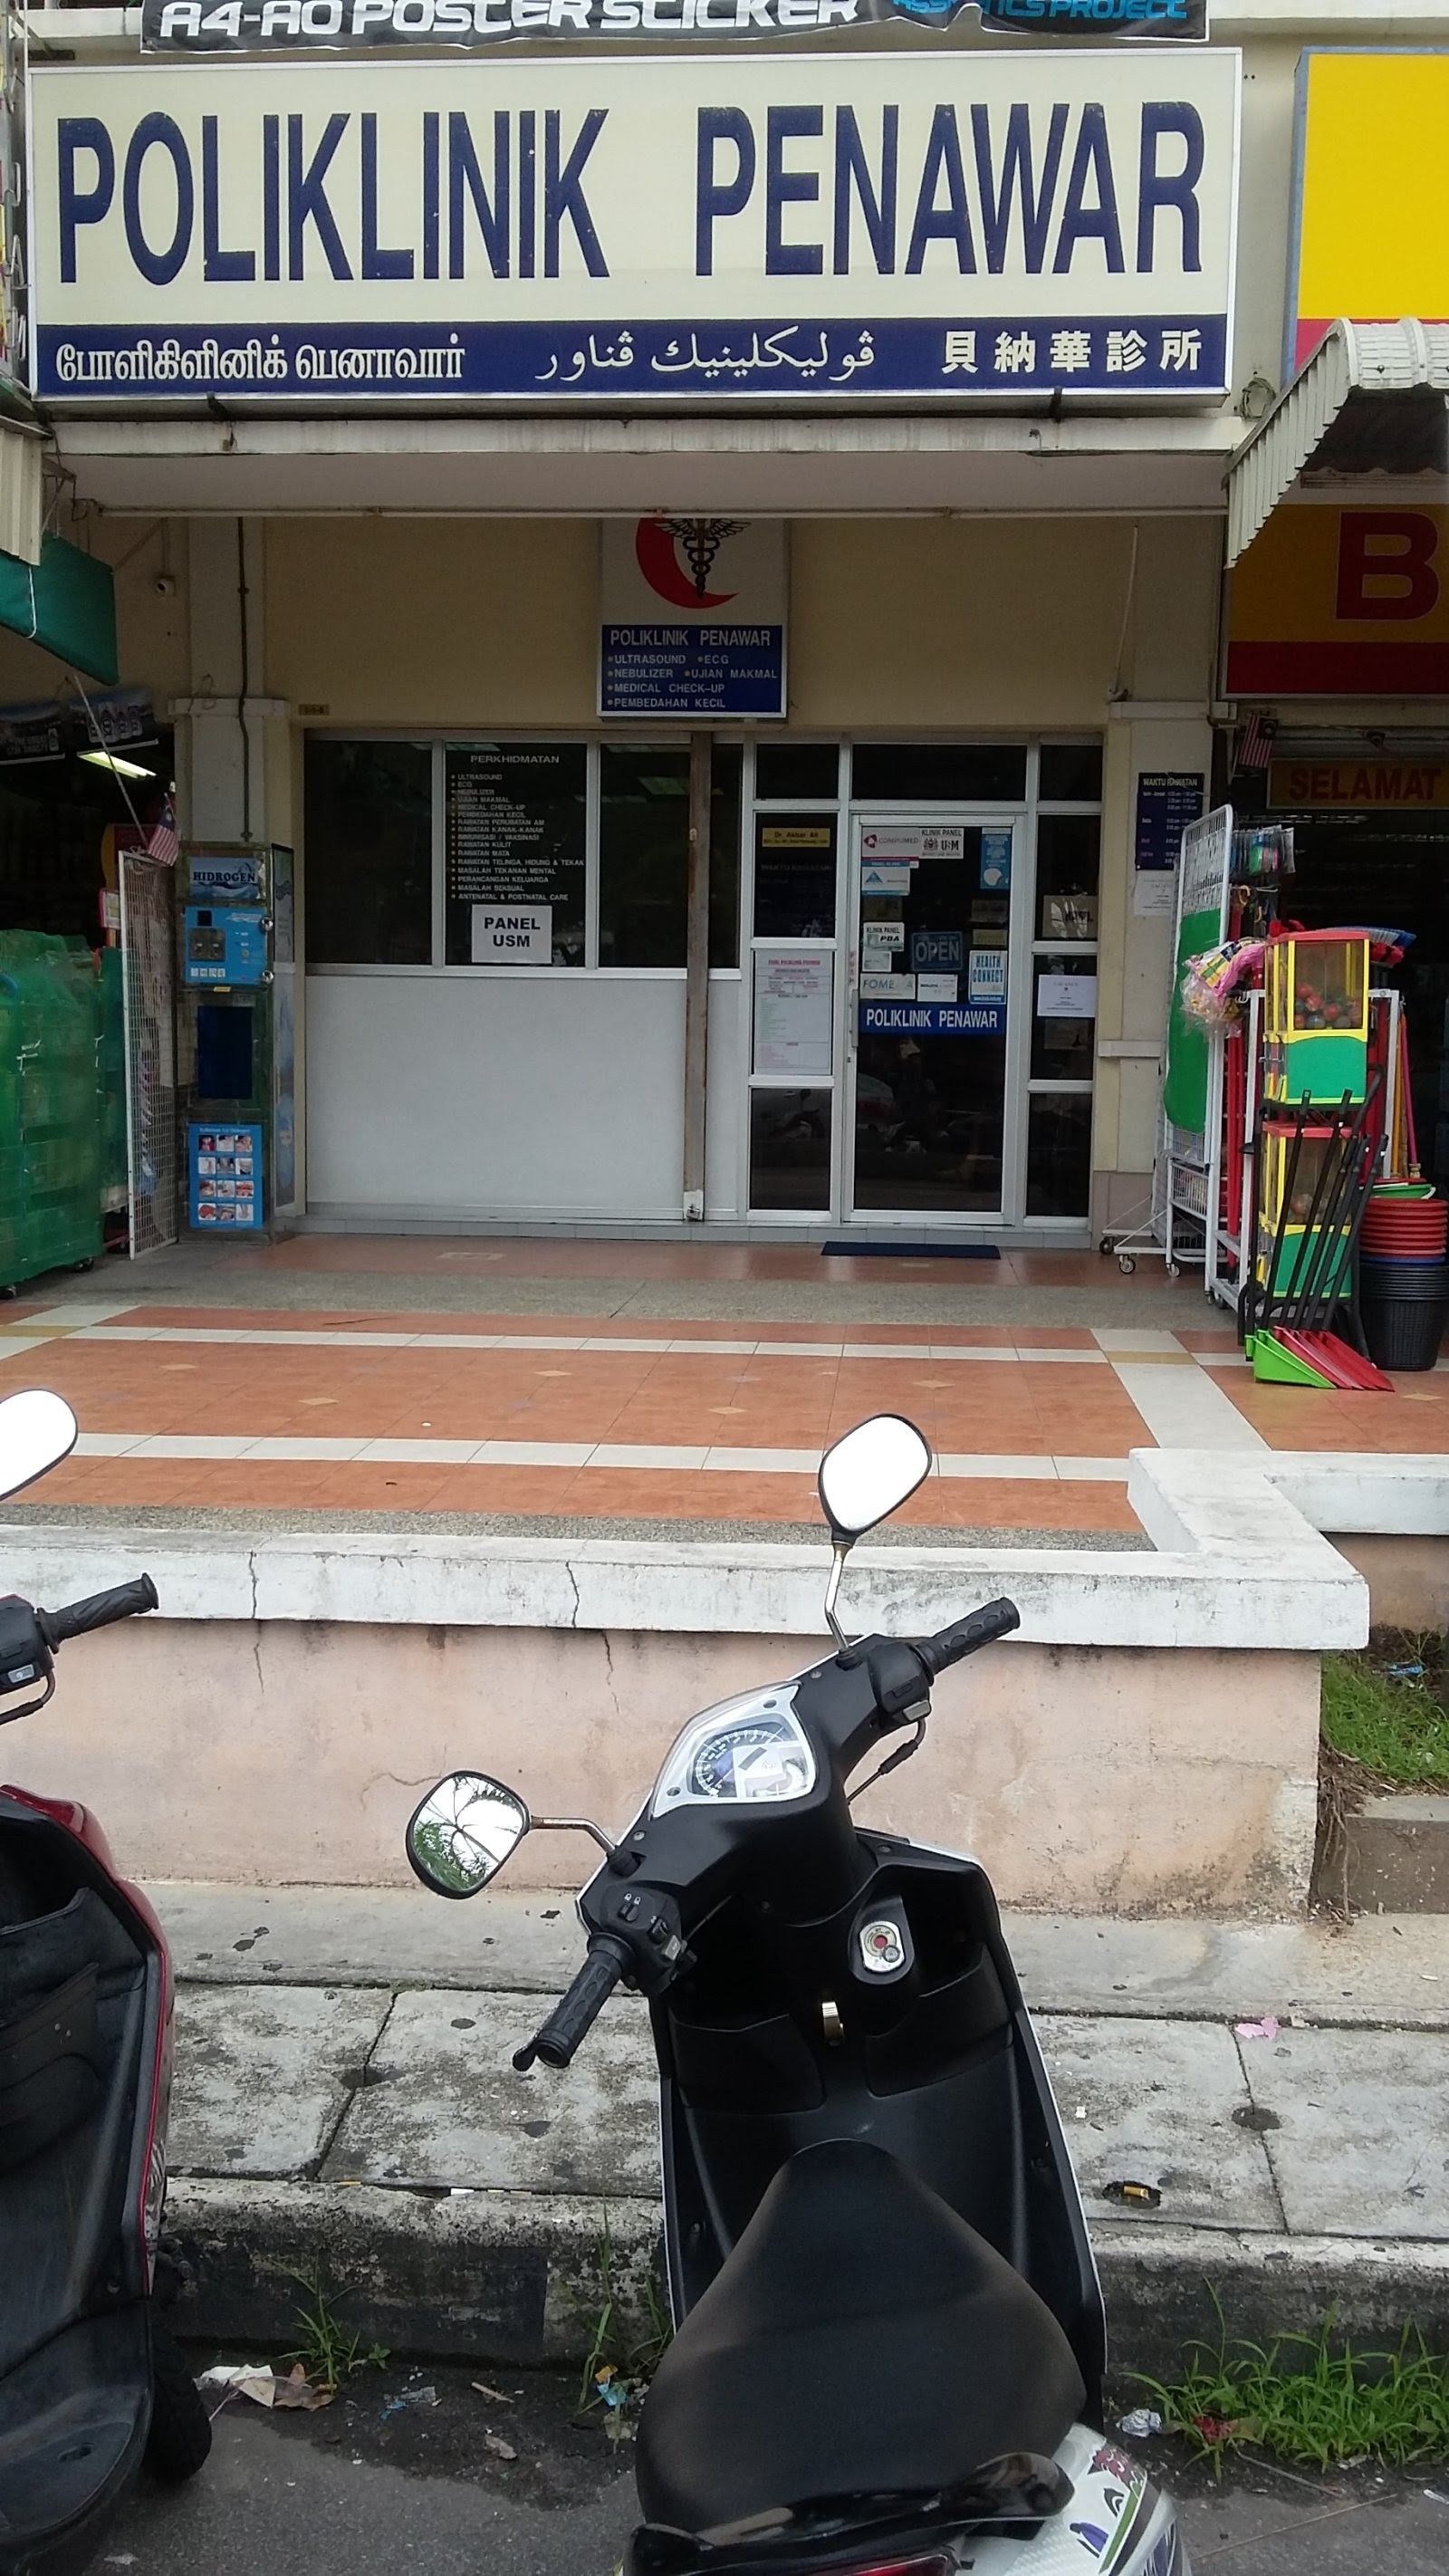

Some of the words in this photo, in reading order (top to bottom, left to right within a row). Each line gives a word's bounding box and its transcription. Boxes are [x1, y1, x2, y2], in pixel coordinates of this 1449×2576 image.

[352, 0, 590, 35] POSTER
[57, 109, 610, 285] POLIKLINIK
[696, 101, 1205, 278] PENAWAR
[941, 329, 1203, 373] 貝納華診所
[1335, 511, 1440, 622] B
[610, 630, 688, 646] POLIKLINIK
[700, 630, 771, 646] PENAWAR
[614, 655, 686, 664] ULTRASOUND
[705, 655, 729, 664] ECG
[614, 668, 674, 678] NEBULIZER
[692, 668, 723, 678] UJIAN
[730, 668, 778, 678] MAKMAL
[614, 683, 661, 693] MEDICAL
[668, 683, 725, 693] CHECK-UP
[614, 697, 688, 707] PEMBEDAHAN
[696, 697, 725, 707] KECIL
[471, 755, 560, 764] PERKHIDMATAN
[1290, 769, 1442, 801] SELAMAT
[193, 871, 255, 882] HIDROGEN
[484, 917, 541, 929] PANEL
[493, 935, 531, 947] USM
[915, 940, 960, 963] OPEN
[975, 956, 1001, 968] HEALTH
[973, 969, 1003, 983] CONNECT
[862, 978, 913, 990] FOMEA
[866, 1009, 932, 1027] POLIKLINIK
[938, 1009, 998, 1027] PENAWAR
